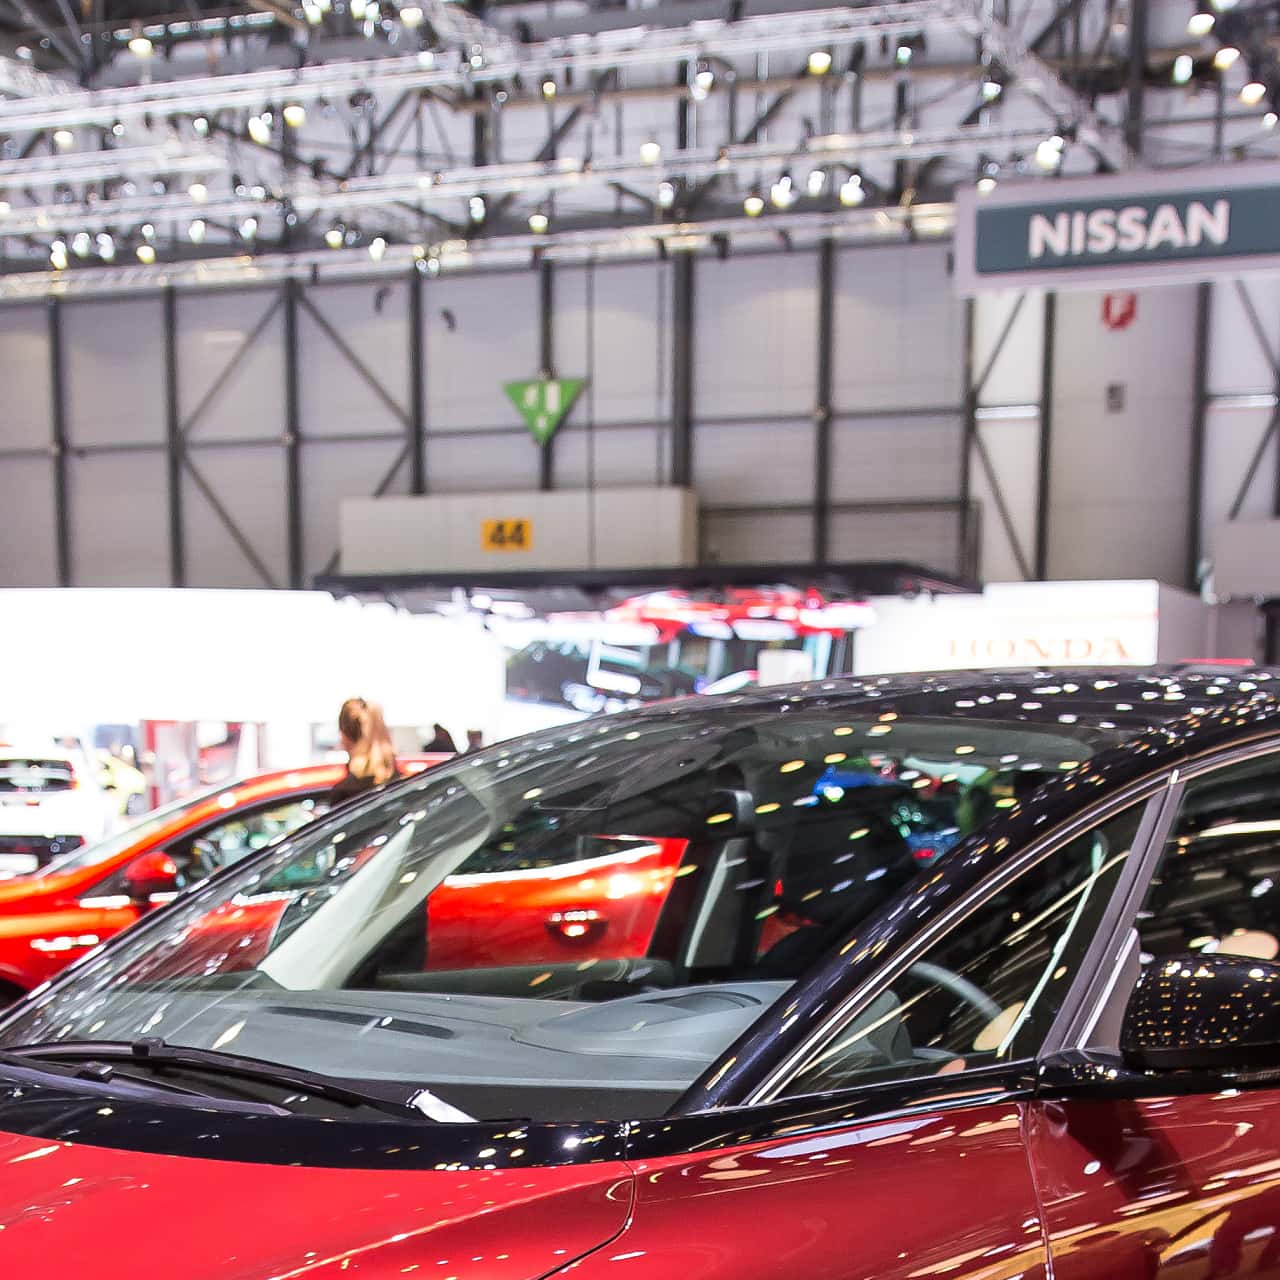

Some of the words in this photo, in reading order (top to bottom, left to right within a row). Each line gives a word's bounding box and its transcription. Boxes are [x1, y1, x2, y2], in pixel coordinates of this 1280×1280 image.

[1028, 199, 1230, 258] NISSAN
[489, 520, 525, 545] 44
[948, 638, 1131, 659] HONDA
